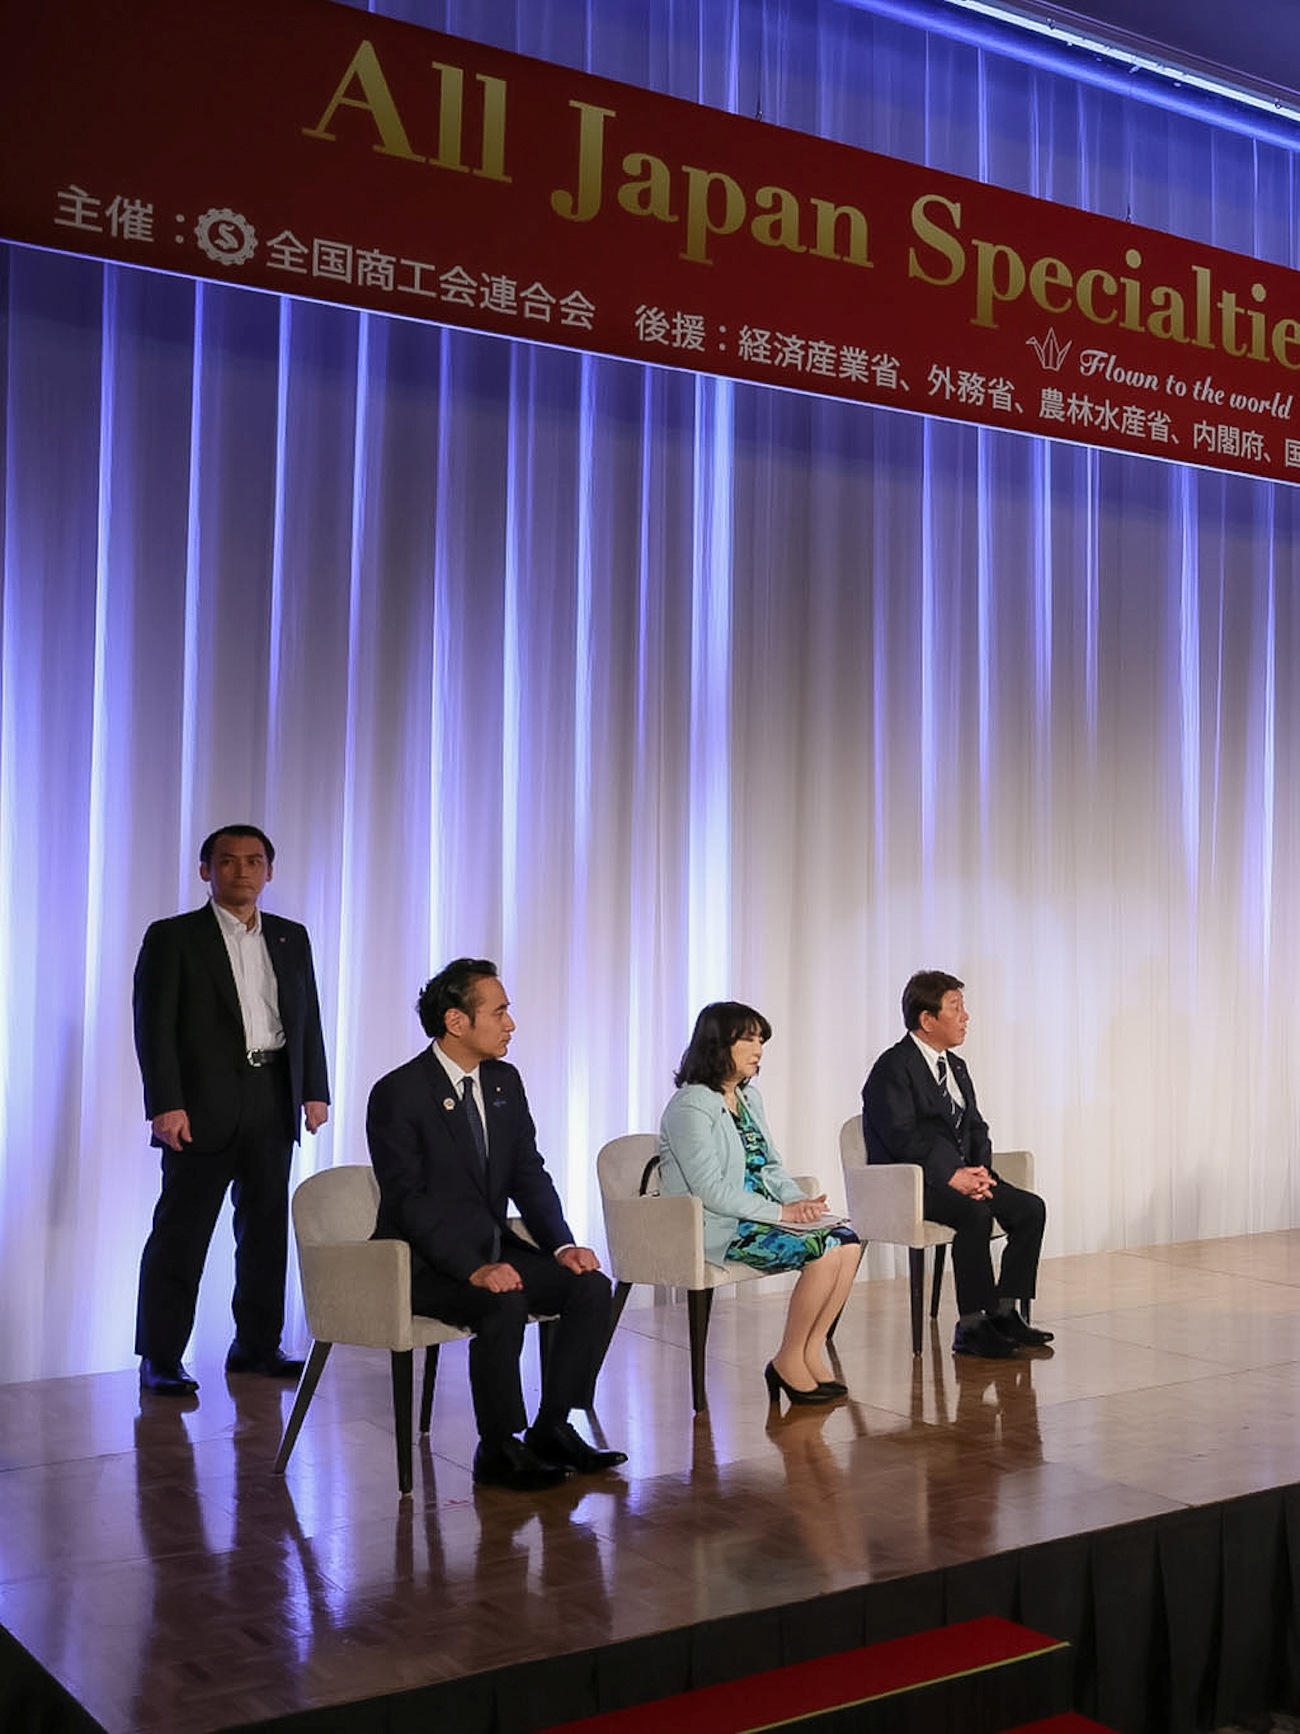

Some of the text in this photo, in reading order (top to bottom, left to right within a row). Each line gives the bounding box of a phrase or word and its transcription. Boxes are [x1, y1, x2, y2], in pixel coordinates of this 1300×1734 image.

[302, 40, 511, 184] All
[551, 100, 874, 269] Japan
[266, 229, 597, 331] 全国商工会連合会
[1079, 348, 1295, 420] Flown to the world
